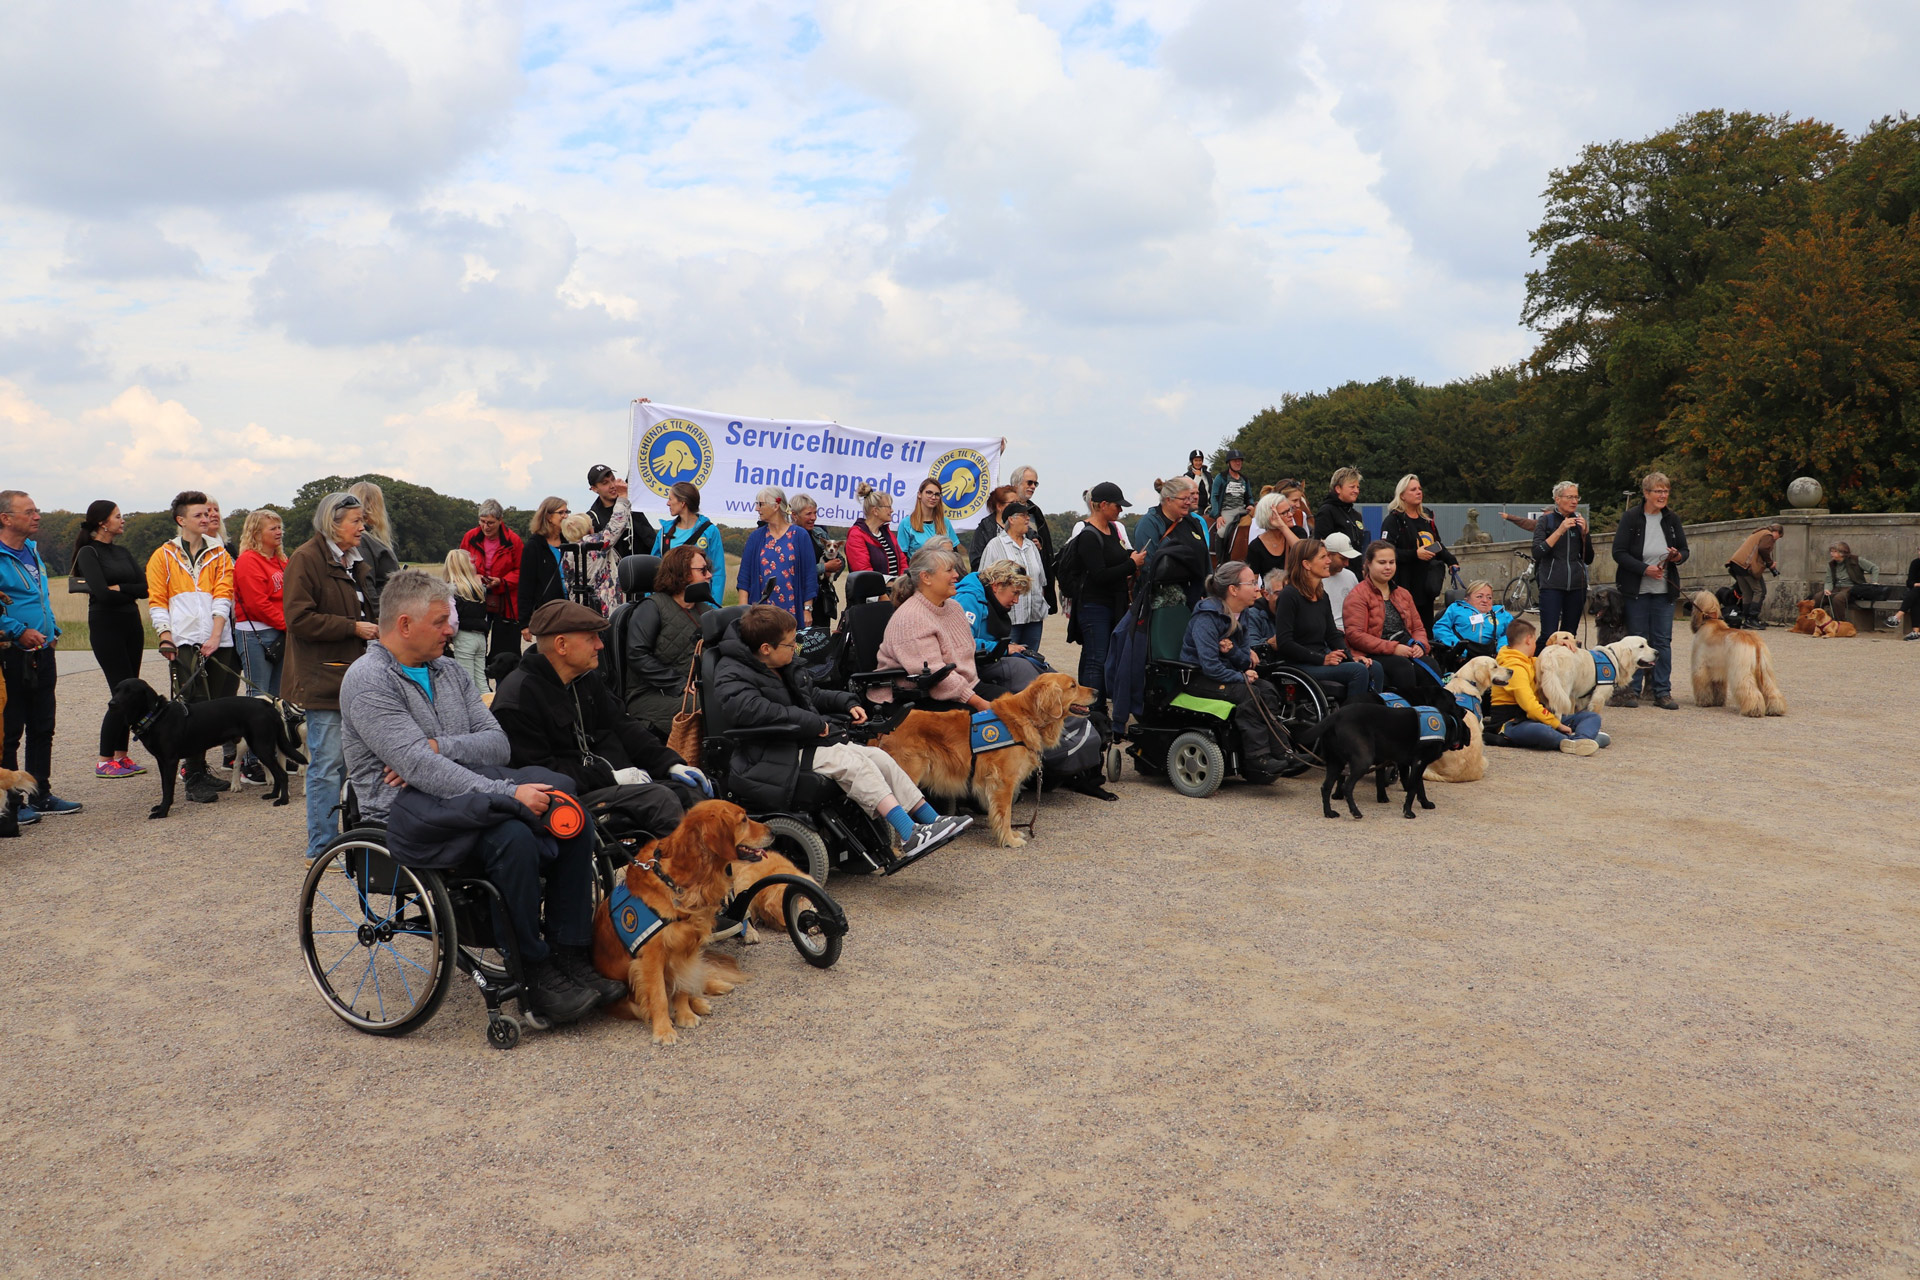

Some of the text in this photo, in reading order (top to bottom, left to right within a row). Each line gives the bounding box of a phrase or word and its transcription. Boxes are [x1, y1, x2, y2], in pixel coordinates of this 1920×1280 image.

[639, 420, 712, 488] SERVICEHUNDE TIL HANDICAPPED
[725, 421, 926, 463] Servicehunde til
[958, 450, 968, 458] TIL
[735, 459, 906, 500] handicappede
[947, 510, 963, 518] STH
